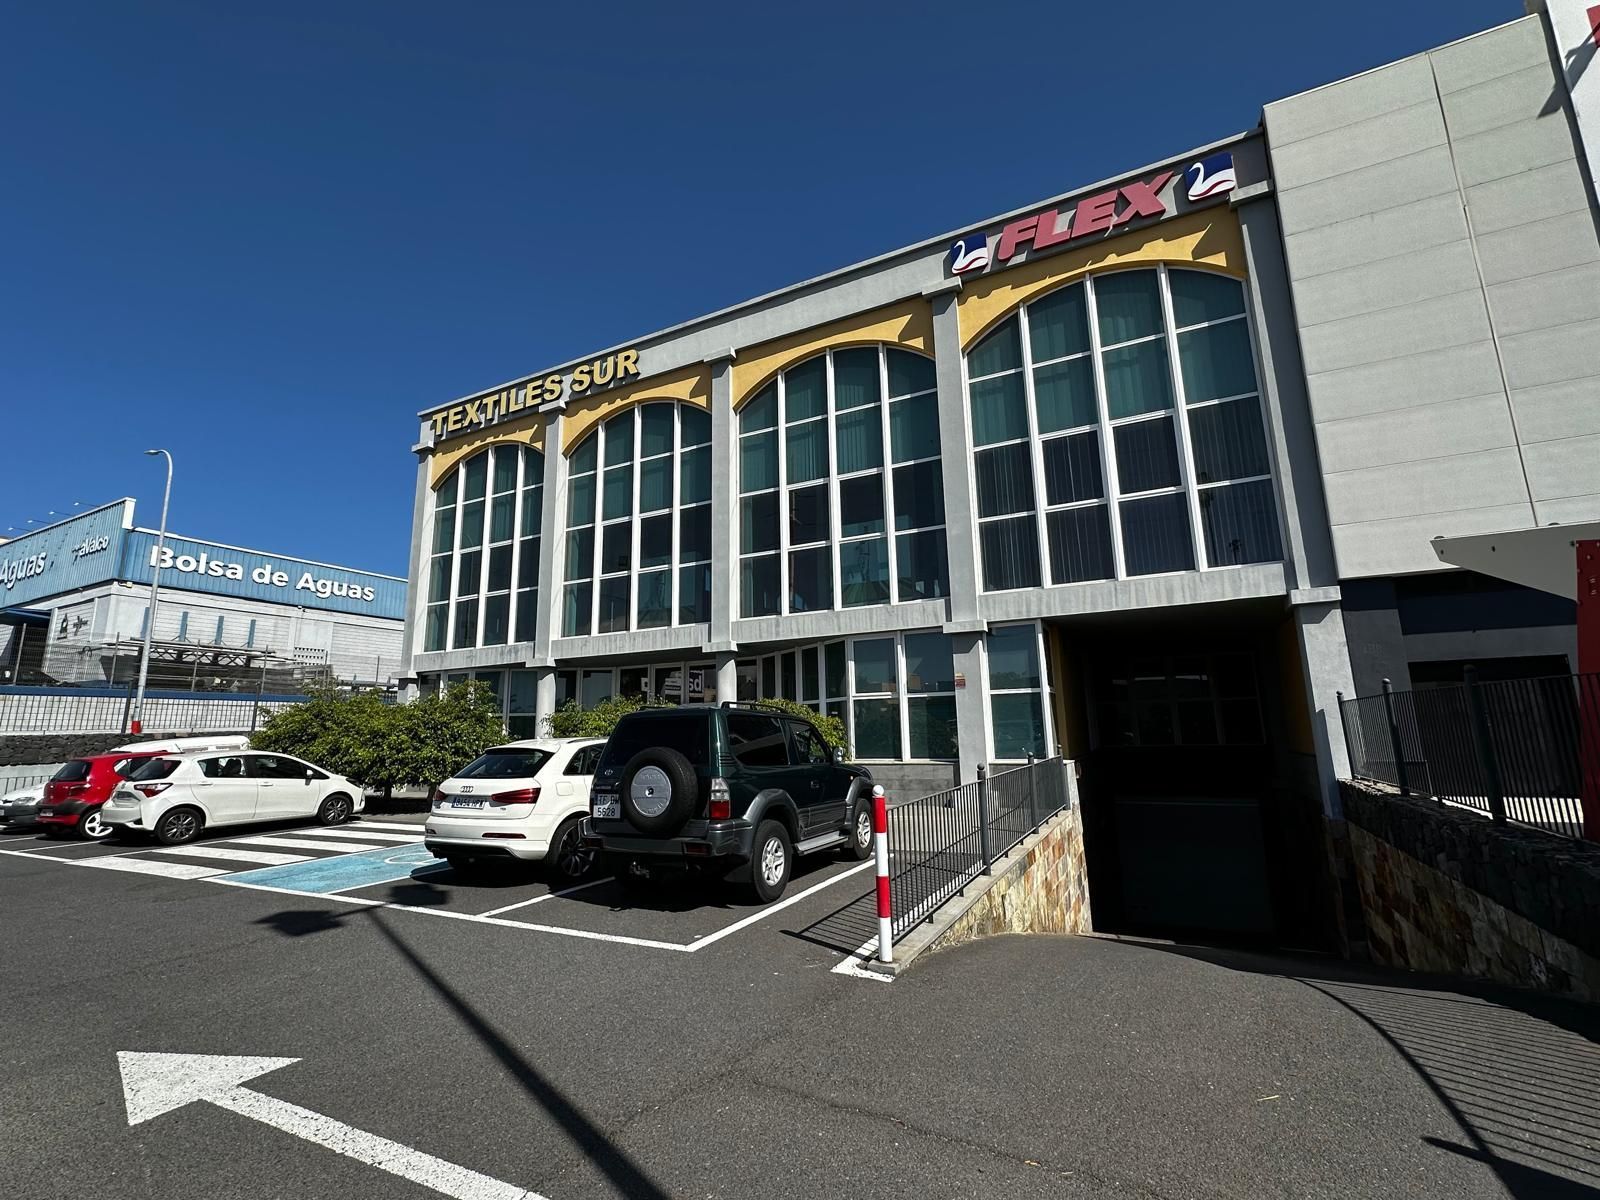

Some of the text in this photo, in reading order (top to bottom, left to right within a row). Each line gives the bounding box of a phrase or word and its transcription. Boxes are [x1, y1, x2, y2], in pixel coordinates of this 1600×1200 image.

[996, 170, 1174, 262] FLEX
[432, 348, 641, 436] TEXTILES SUR
[0, 551, 47, 589] Aguas
[149, 545, 375, 602] Bolsa de Aguas
[597, 807, 616, 817] 5628
